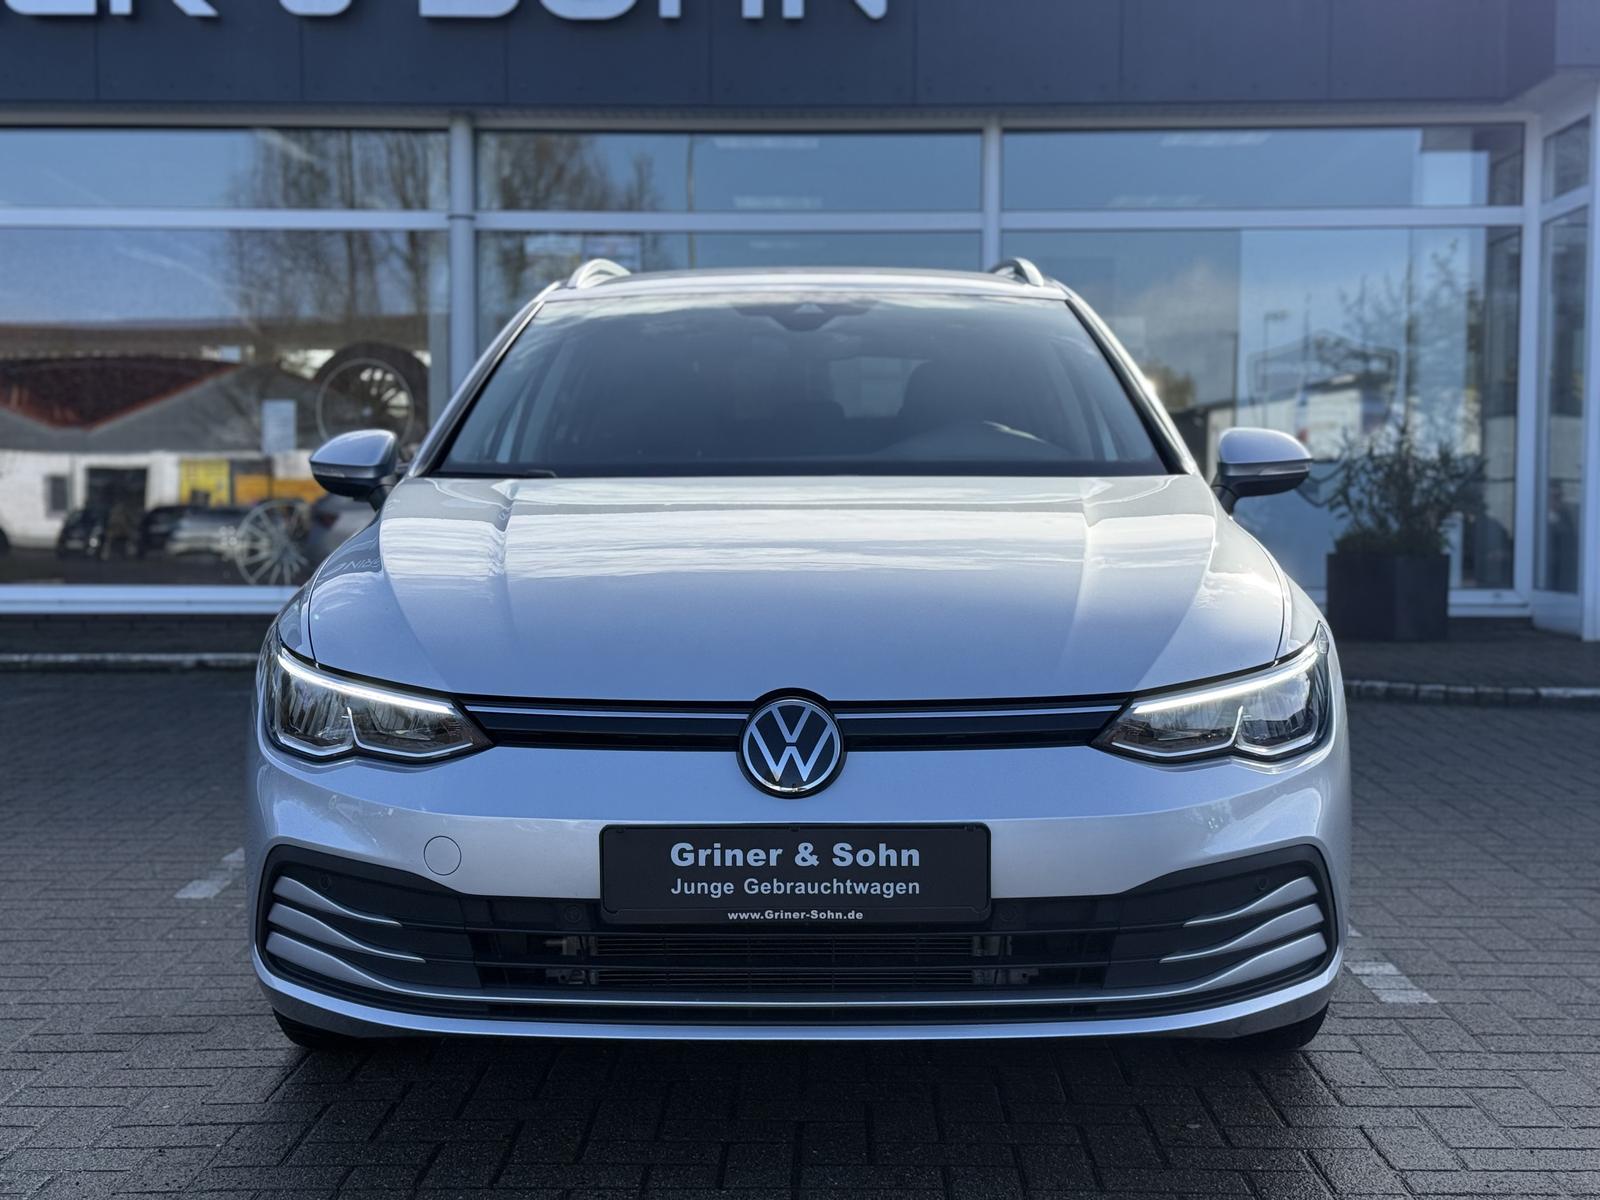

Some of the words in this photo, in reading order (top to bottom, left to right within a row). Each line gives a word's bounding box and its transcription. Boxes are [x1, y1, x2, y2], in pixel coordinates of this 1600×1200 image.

[748, 703, 835, 784] VW
[670, 842, 784, 867] Griner
[794, 842, 820, 867] &
[831, 842, 921, 867] Sohn
[670, 878, 735, 899] Junge
[743, 877, 921, 899] Gebrauchtwagen
[727, 909, 864, 921] www.Griner-Sohn.de
